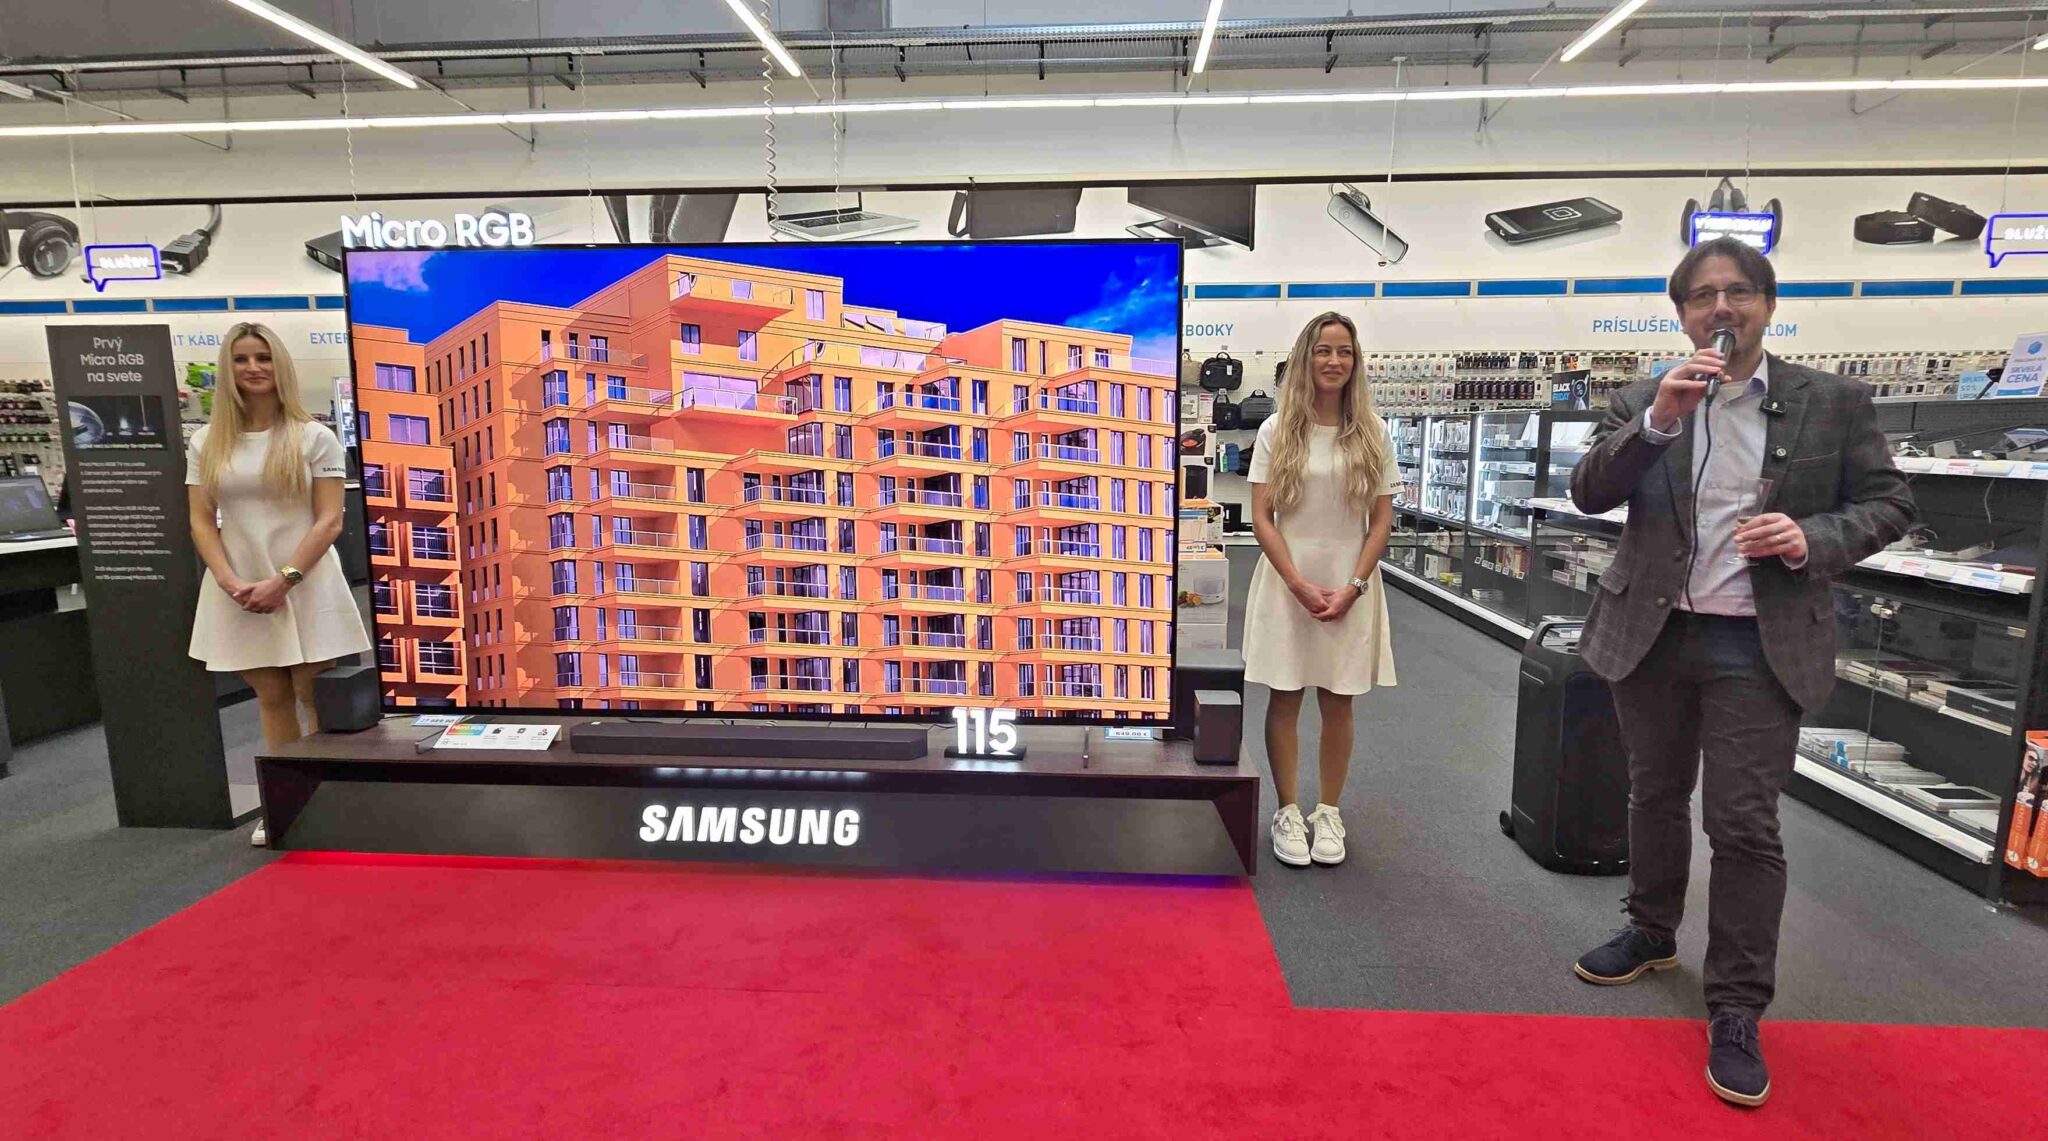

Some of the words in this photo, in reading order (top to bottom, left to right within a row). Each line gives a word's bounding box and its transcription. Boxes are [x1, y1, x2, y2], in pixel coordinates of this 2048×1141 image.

[341, 211, 449, 249] Micro
[454, 212, 535, 248] RGB
[1592, 315, 1685, 333] PRÍSLUŠEN
[93, 336, 123, 352] Prvý
[173, 335, 184, 346] IT
[80, 353, 116, 366] Micro
[118, 354, 145, 365] RGB
[86, 372, 105, 382] na
[106, 370, 142, 382] svete
[2006, 373, 2039, 384] CENA
[1552, 383, 1571, 393] BLACK
[952, 707, 1017, 755] 115
[639, 804, 861, 847] SAMSUNG
